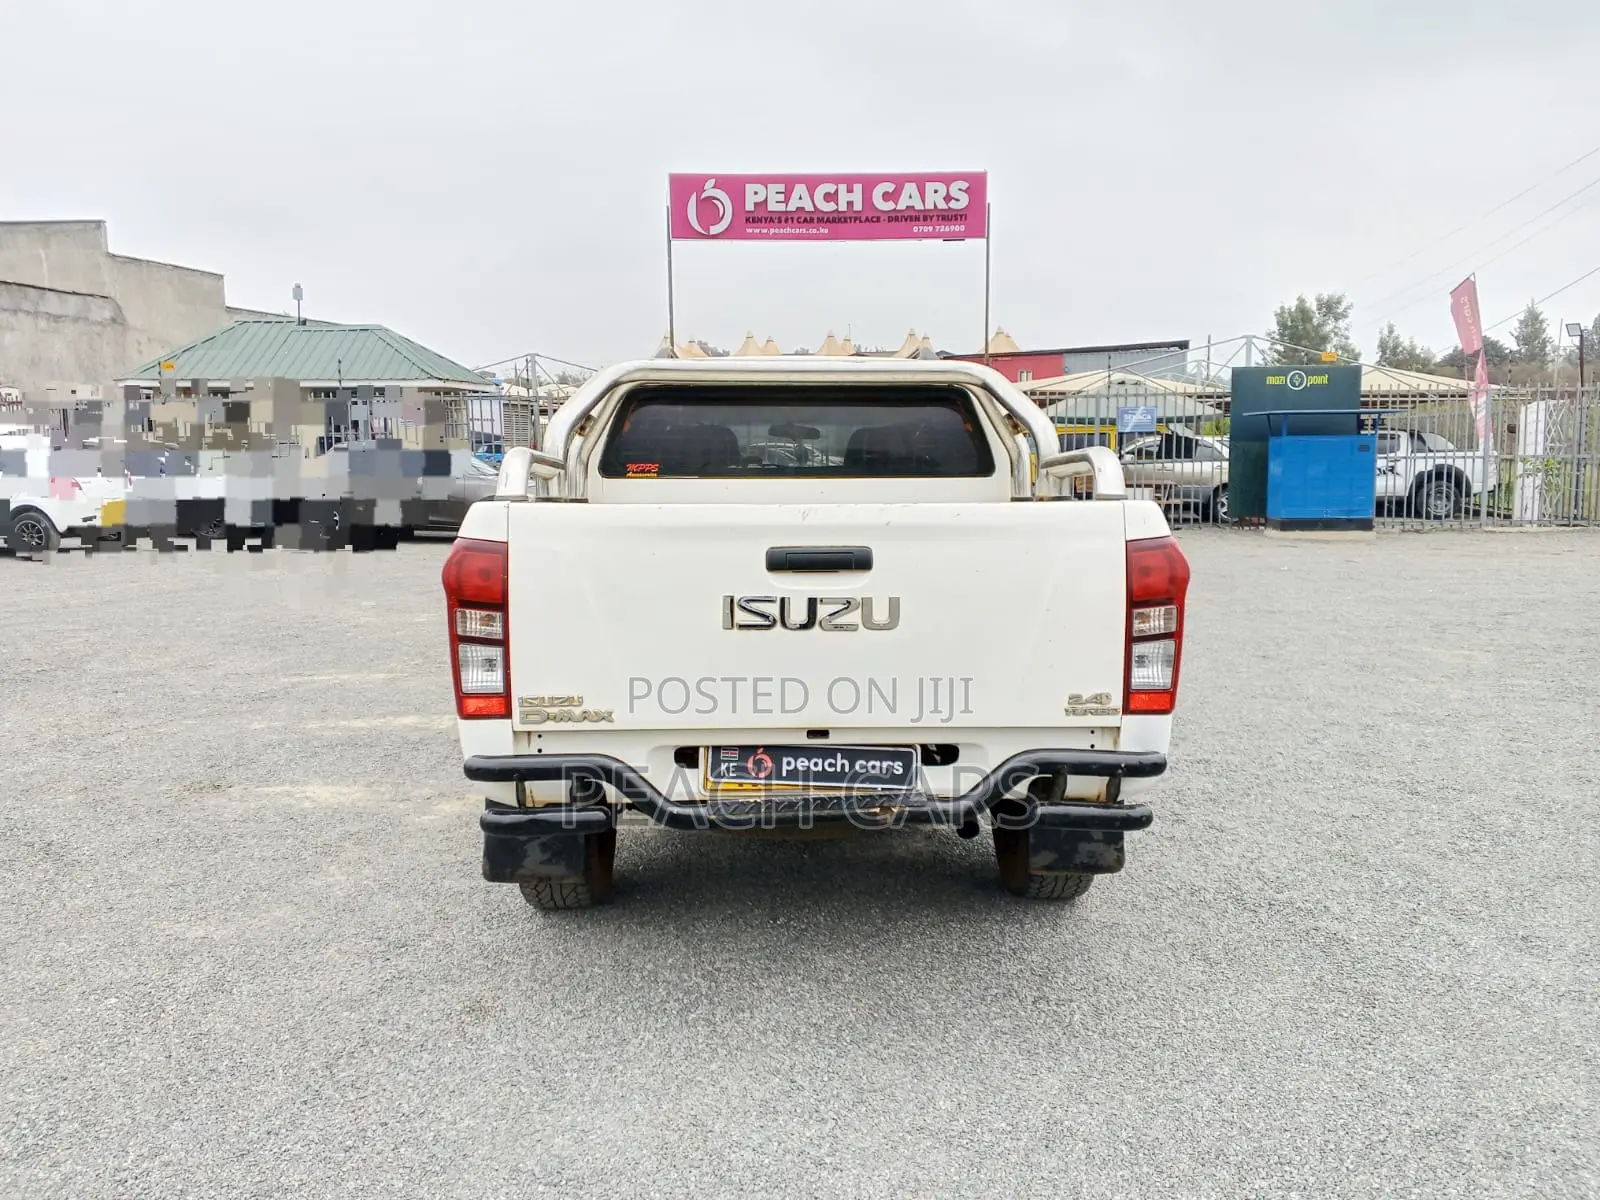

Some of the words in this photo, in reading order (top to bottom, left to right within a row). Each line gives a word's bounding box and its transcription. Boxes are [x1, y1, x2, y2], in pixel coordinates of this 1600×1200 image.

[745, 183, 863, 212] PEACH
[872, 180, 970, 211] CARS
[745, 216, 783, 224] KENYA'S
[796, 216, 815, 224] CAR
[816, 215, 881, 224] MARKETPLACE
[887, 215, 920, 223] DRIVEN
[922, 214, 935, 222] BY
[1307, 374, 1329, 387] point
[722, 595, 900, 631] ISUZU
[518, 695, 583, 707] ISUZU
[720, 762, 736, 776] KE
[782, 753, 849, 776] peach
[855, 760, 904, 775] cars
